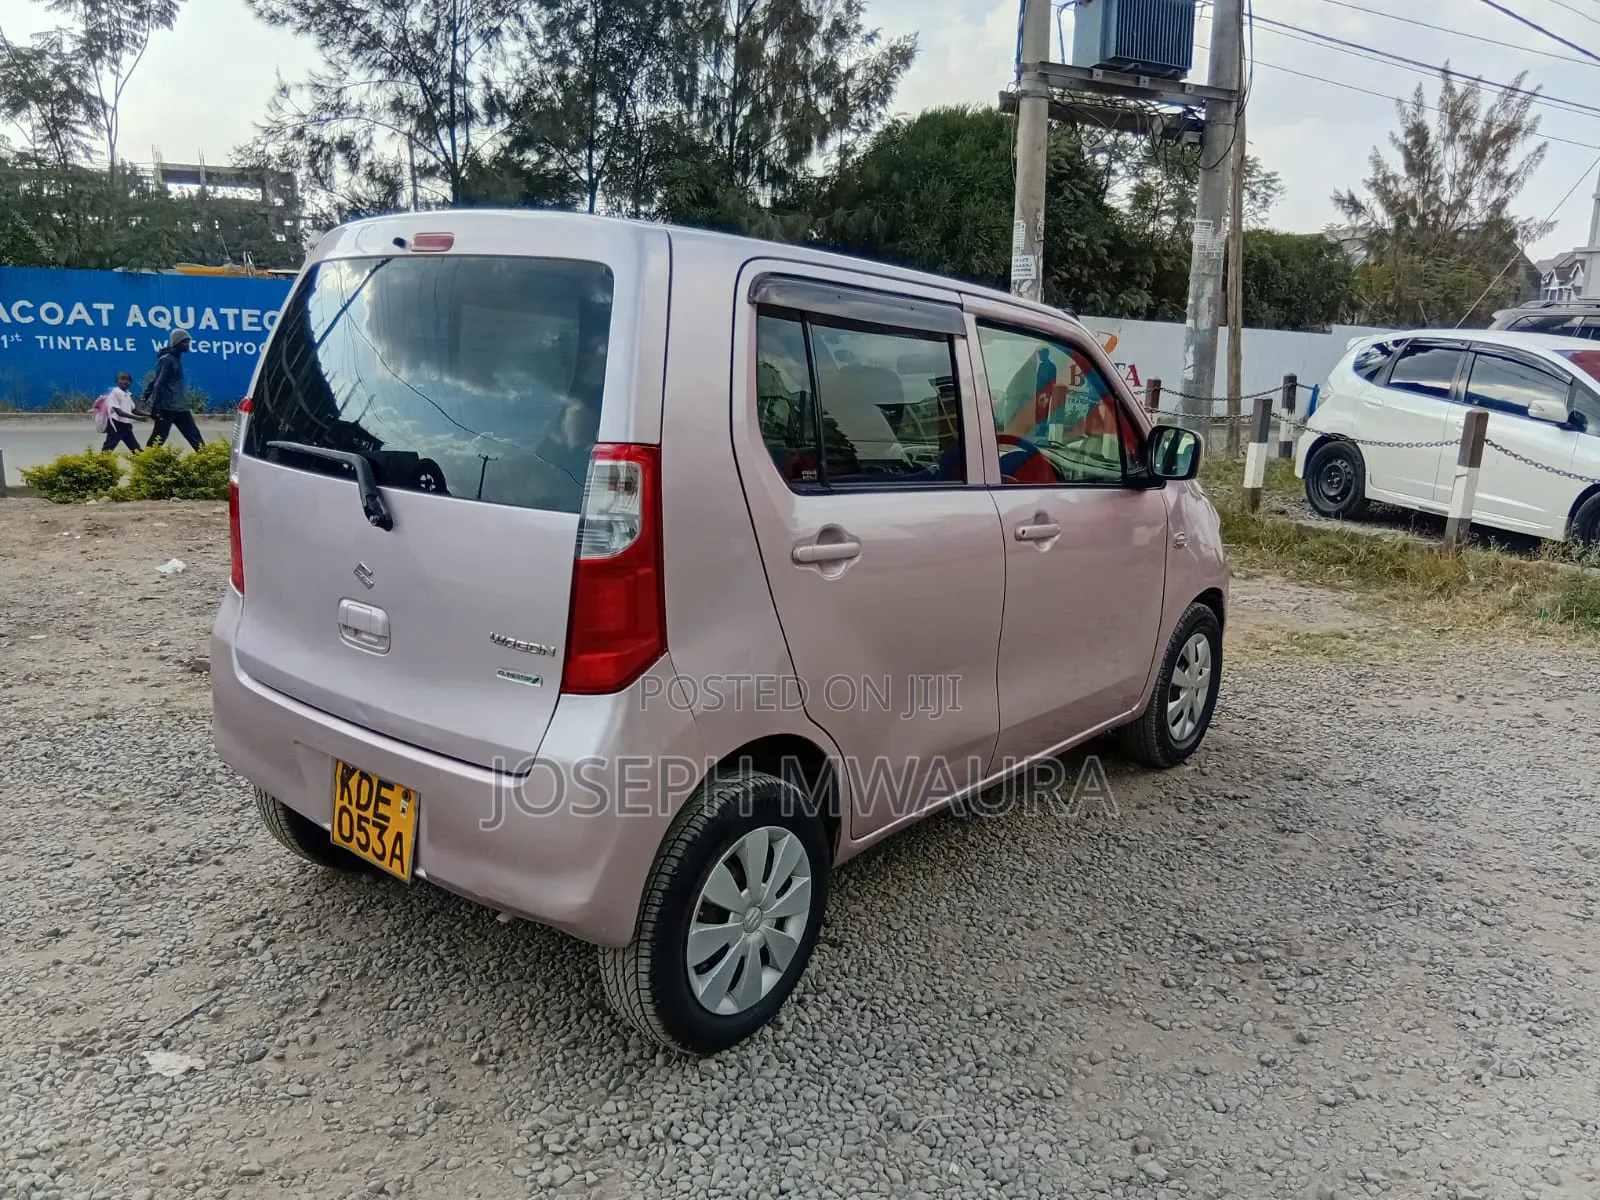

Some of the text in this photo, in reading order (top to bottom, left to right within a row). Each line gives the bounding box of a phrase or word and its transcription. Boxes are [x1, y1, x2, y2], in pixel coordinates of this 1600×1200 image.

[0, 332, 22, 348] 1st
[35, 336, 137, 351] TINTABLE
[340, 763, 395, 823] KDE
[338, 804, 405, 875] 053A
